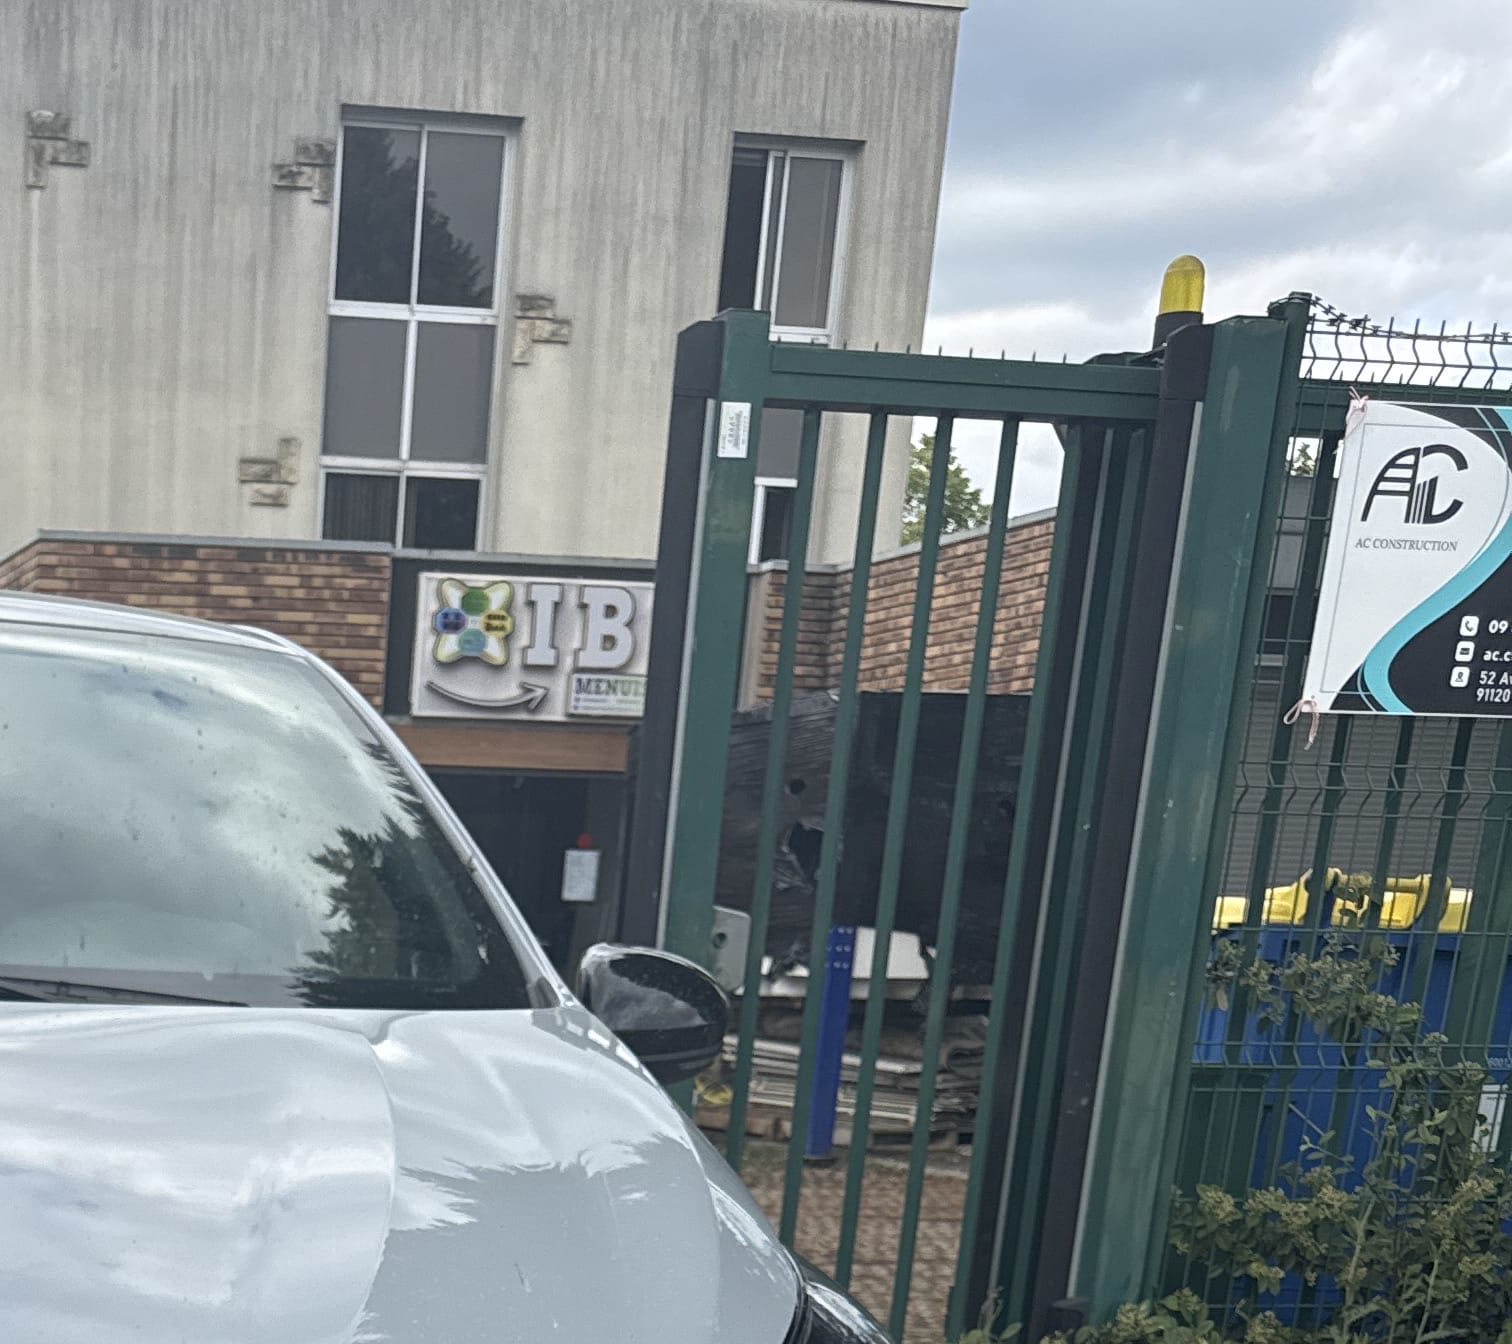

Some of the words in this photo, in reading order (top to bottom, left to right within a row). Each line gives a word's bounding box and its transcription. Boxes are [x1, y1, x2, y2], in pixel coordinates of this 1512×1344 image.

[1355, 538, 1372, 549] AC
[1372, 538, 1459, 552] CONSTRUCTION
[1488, 619, 1509, 634] 09
[1479, 670, 1496, 685] 52
[1476, 687, 1511, 703] 91120
